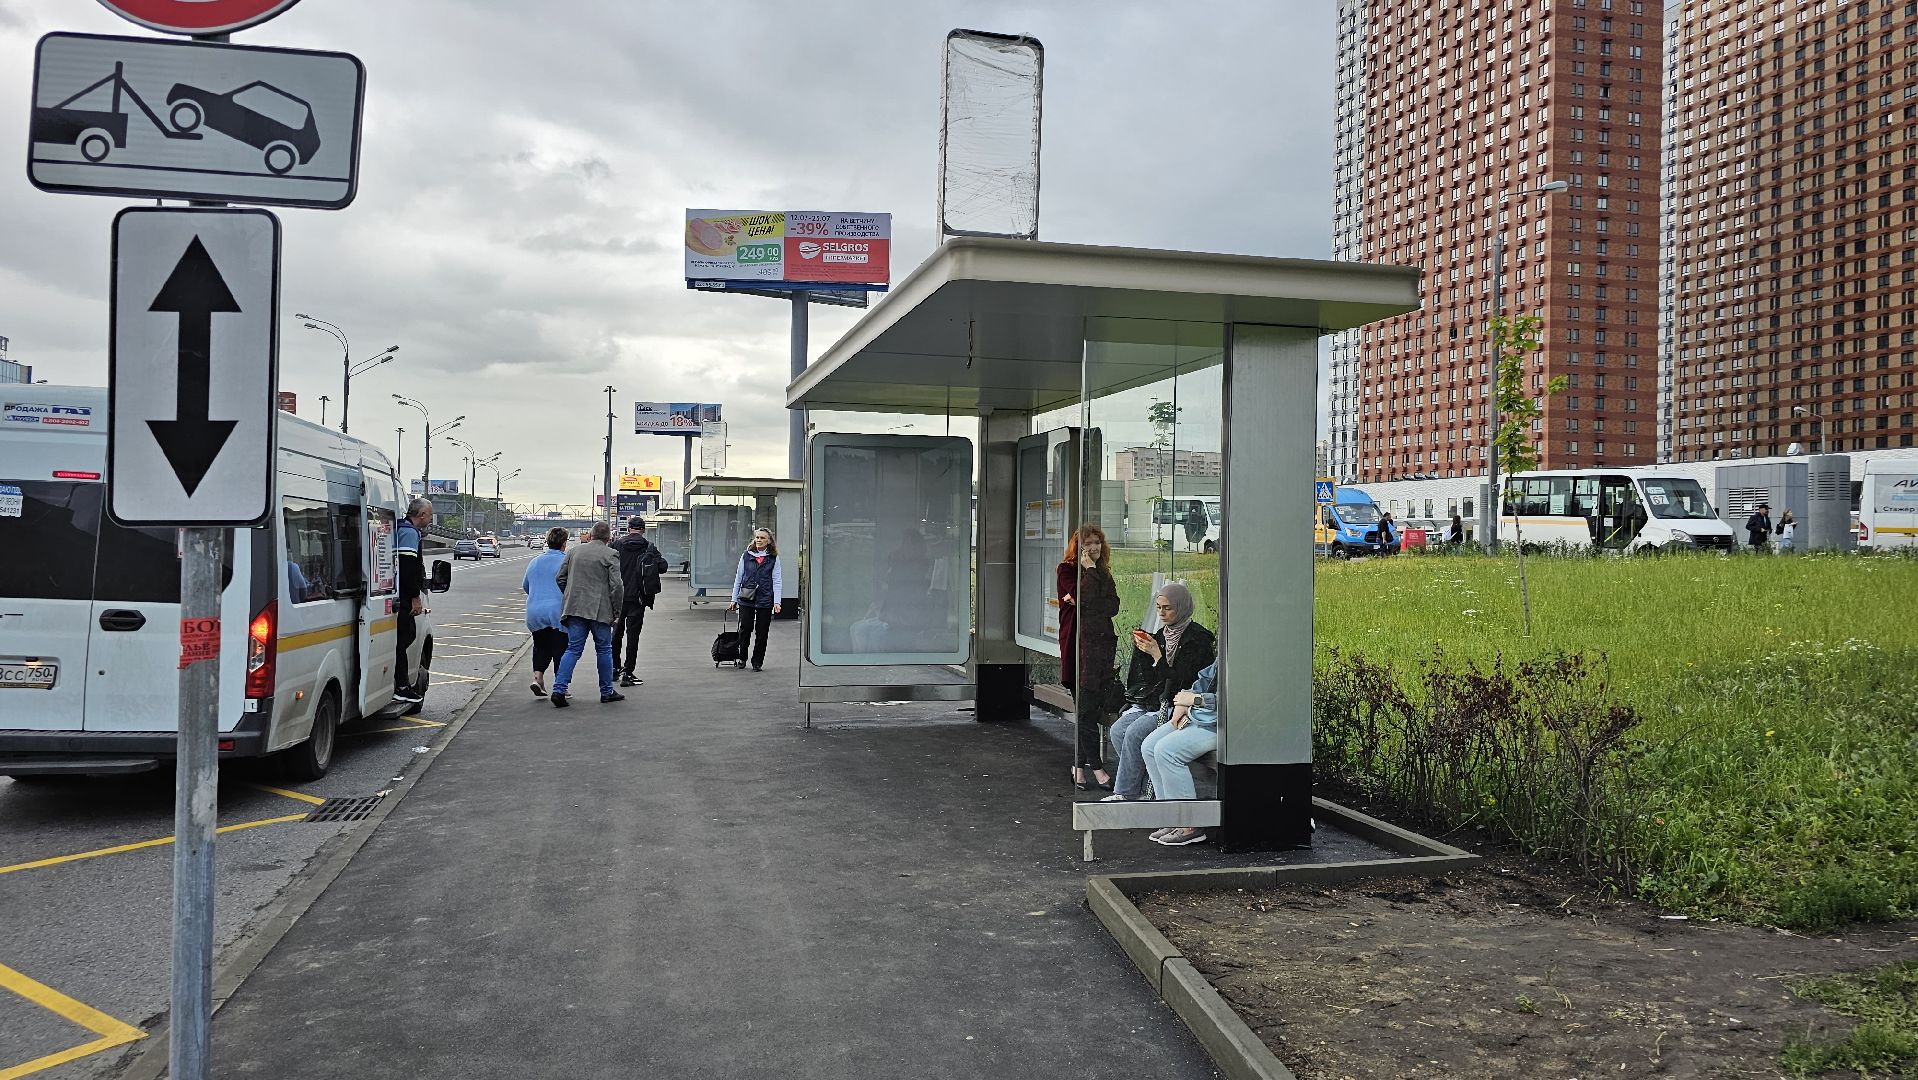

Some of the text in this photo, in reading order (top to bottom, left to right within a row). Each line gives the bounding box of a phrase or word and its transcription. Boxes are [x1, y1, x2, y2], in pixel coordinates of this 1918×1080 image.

[749, 215, 772, 226] ШОК
[748, 225, 775, 237] ЦЕНА!
[790, 222, 829, 236] -39%
[823, 242, 869, 252] SELGROS
[739, 246, 765, 260] 249
[4, 405, 91, 415] ПРОДАЖА ГАЗ
[670, 416, 694, 427] 18%
[1652, 496, 1664, 505] 67
[28, 667, 51, 678] 750
